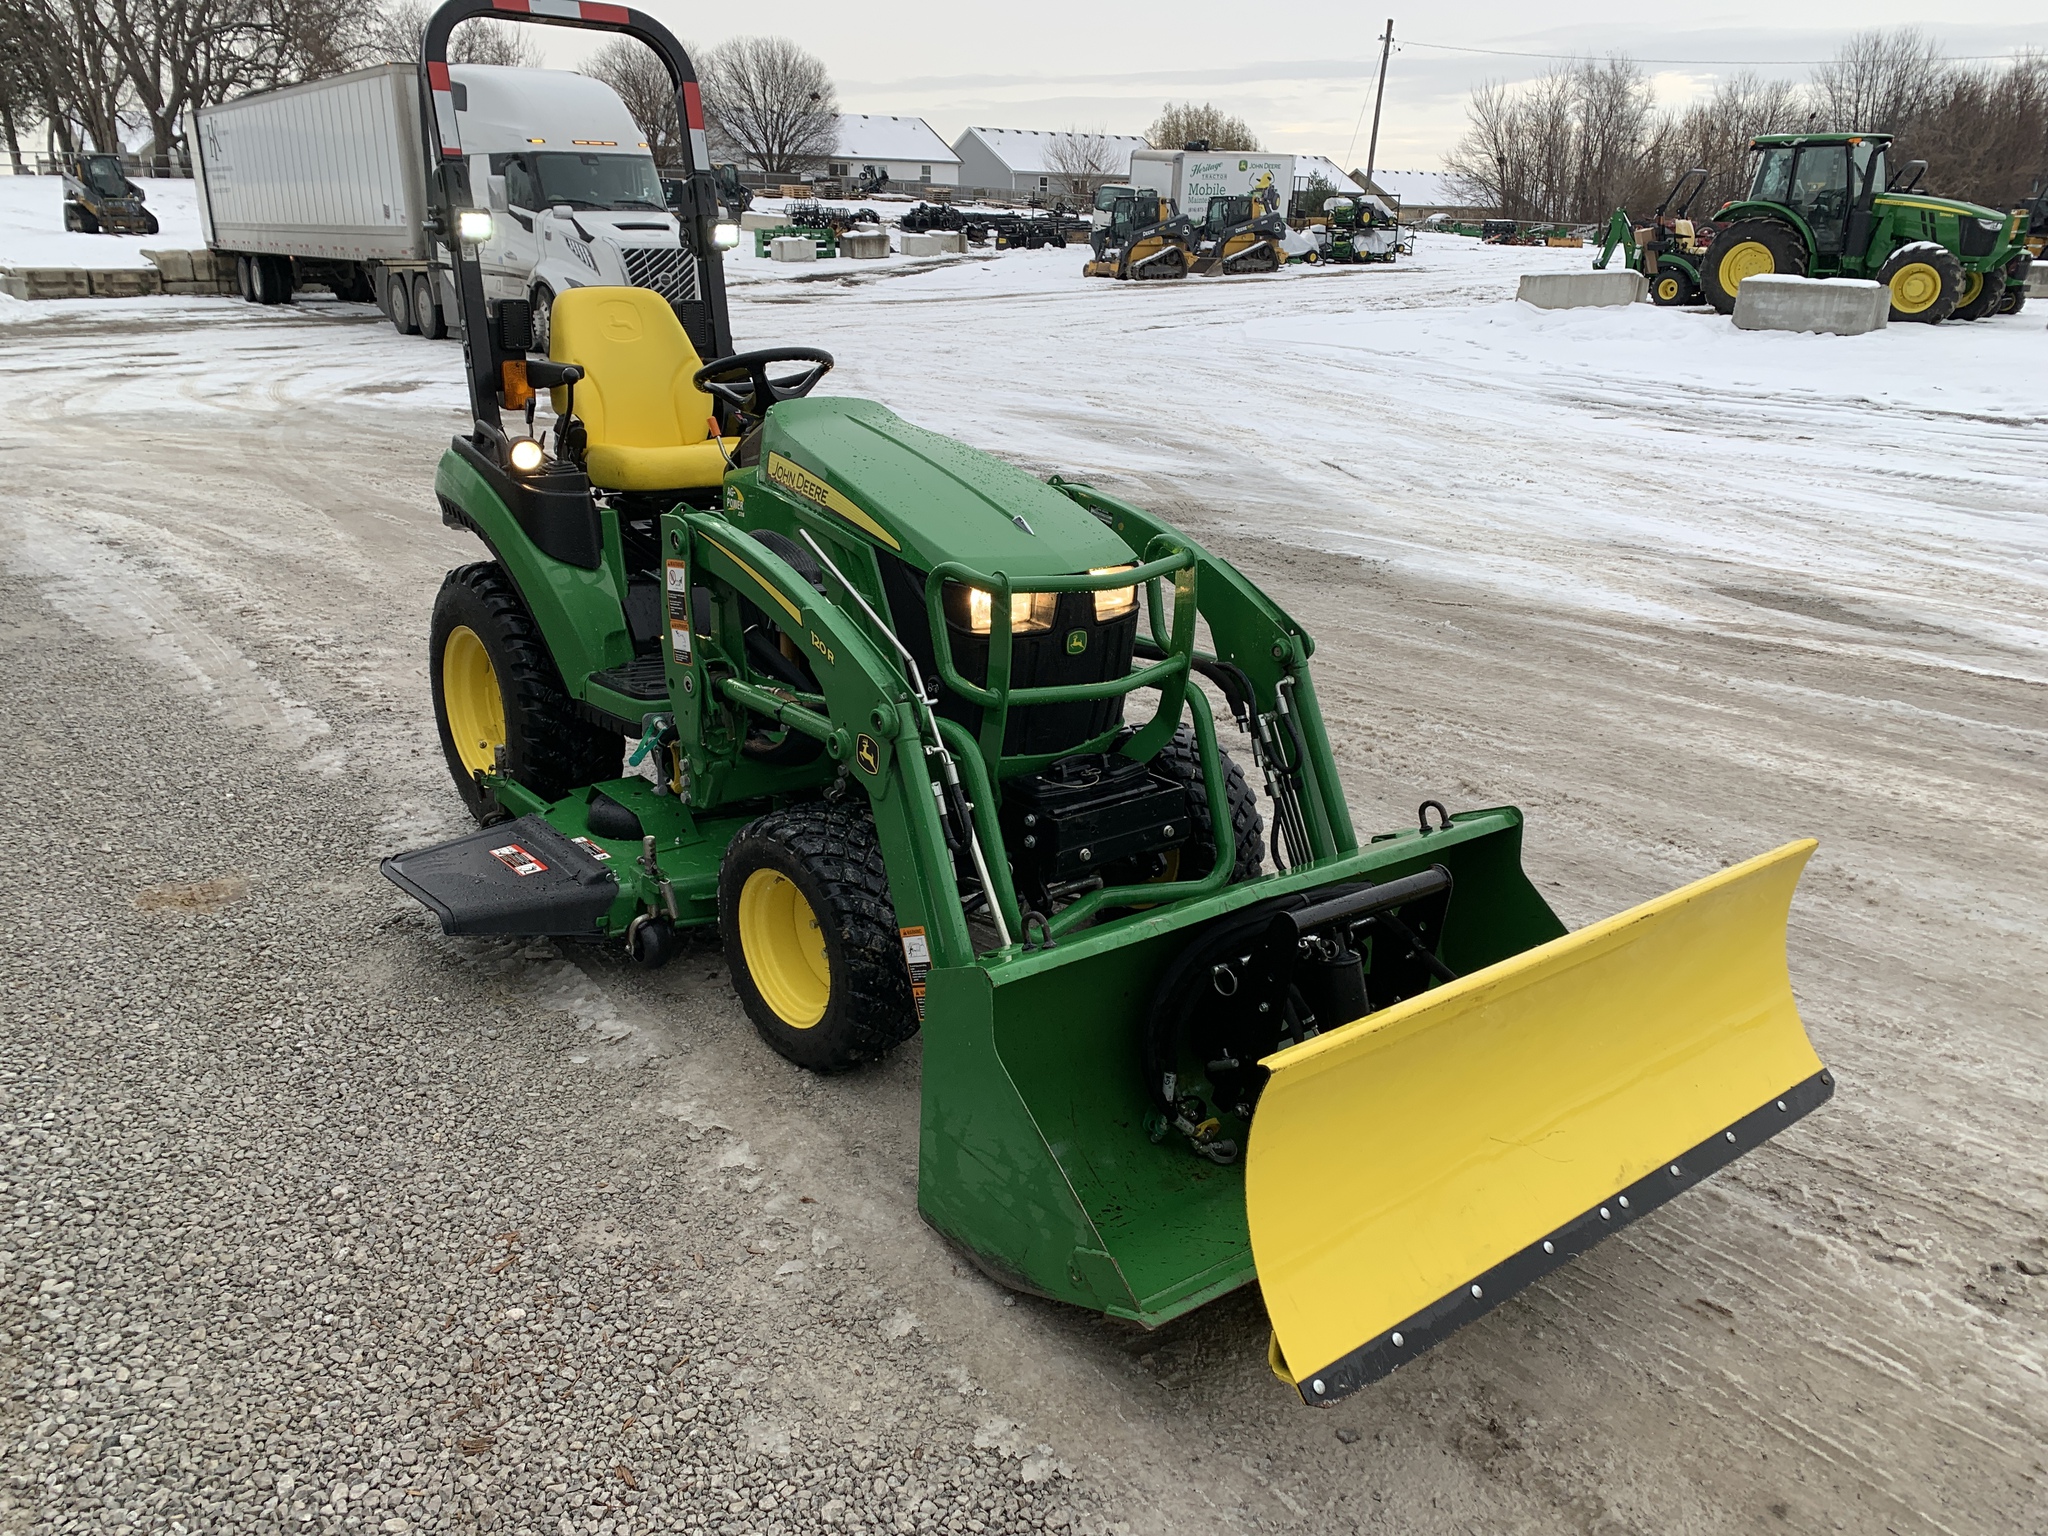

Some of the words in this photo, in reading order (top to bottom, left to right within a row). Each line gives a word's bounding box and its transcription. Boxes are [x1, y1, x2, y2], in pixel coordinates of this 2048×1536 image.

[1190, 162, 1223, 177] Heritage
[1188, 183, 1226, 196] Mobile
[1188, 196, 1208, 204] Mainte
[772, 462, 796, 487] JOHN
[796, 473, 828, 504] DEERE
[727, 498, 744, 510] POWER
